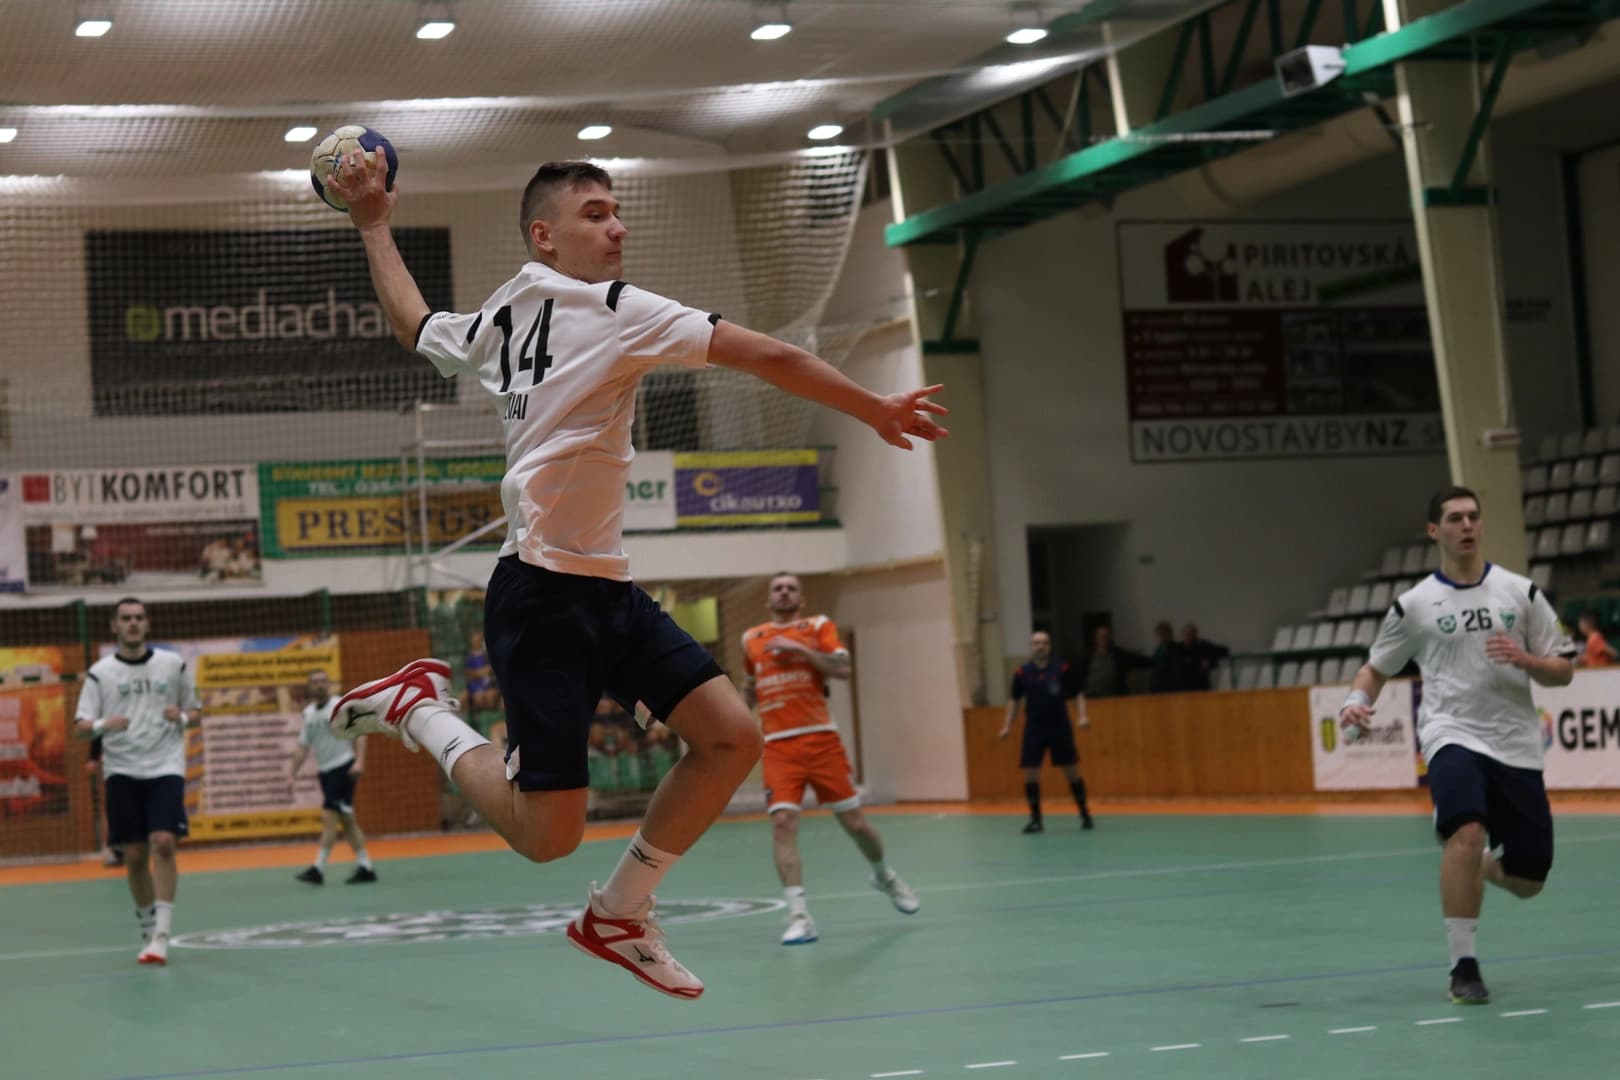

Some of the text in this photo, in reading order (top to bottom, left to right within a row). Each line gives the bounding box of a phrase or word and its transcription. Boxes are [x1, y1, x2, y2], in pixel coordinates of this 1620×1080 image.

[1243, 237, 1409, 267] PIRITOVSKÁ
[1246, 279, 1313, 302] ALEJ
[494, 298, 553, 393] 14
[1461, 607, 1493, 632] 26
[132, 678, 151, 695] 31
[1558, 707, 1620, 751] GEM
